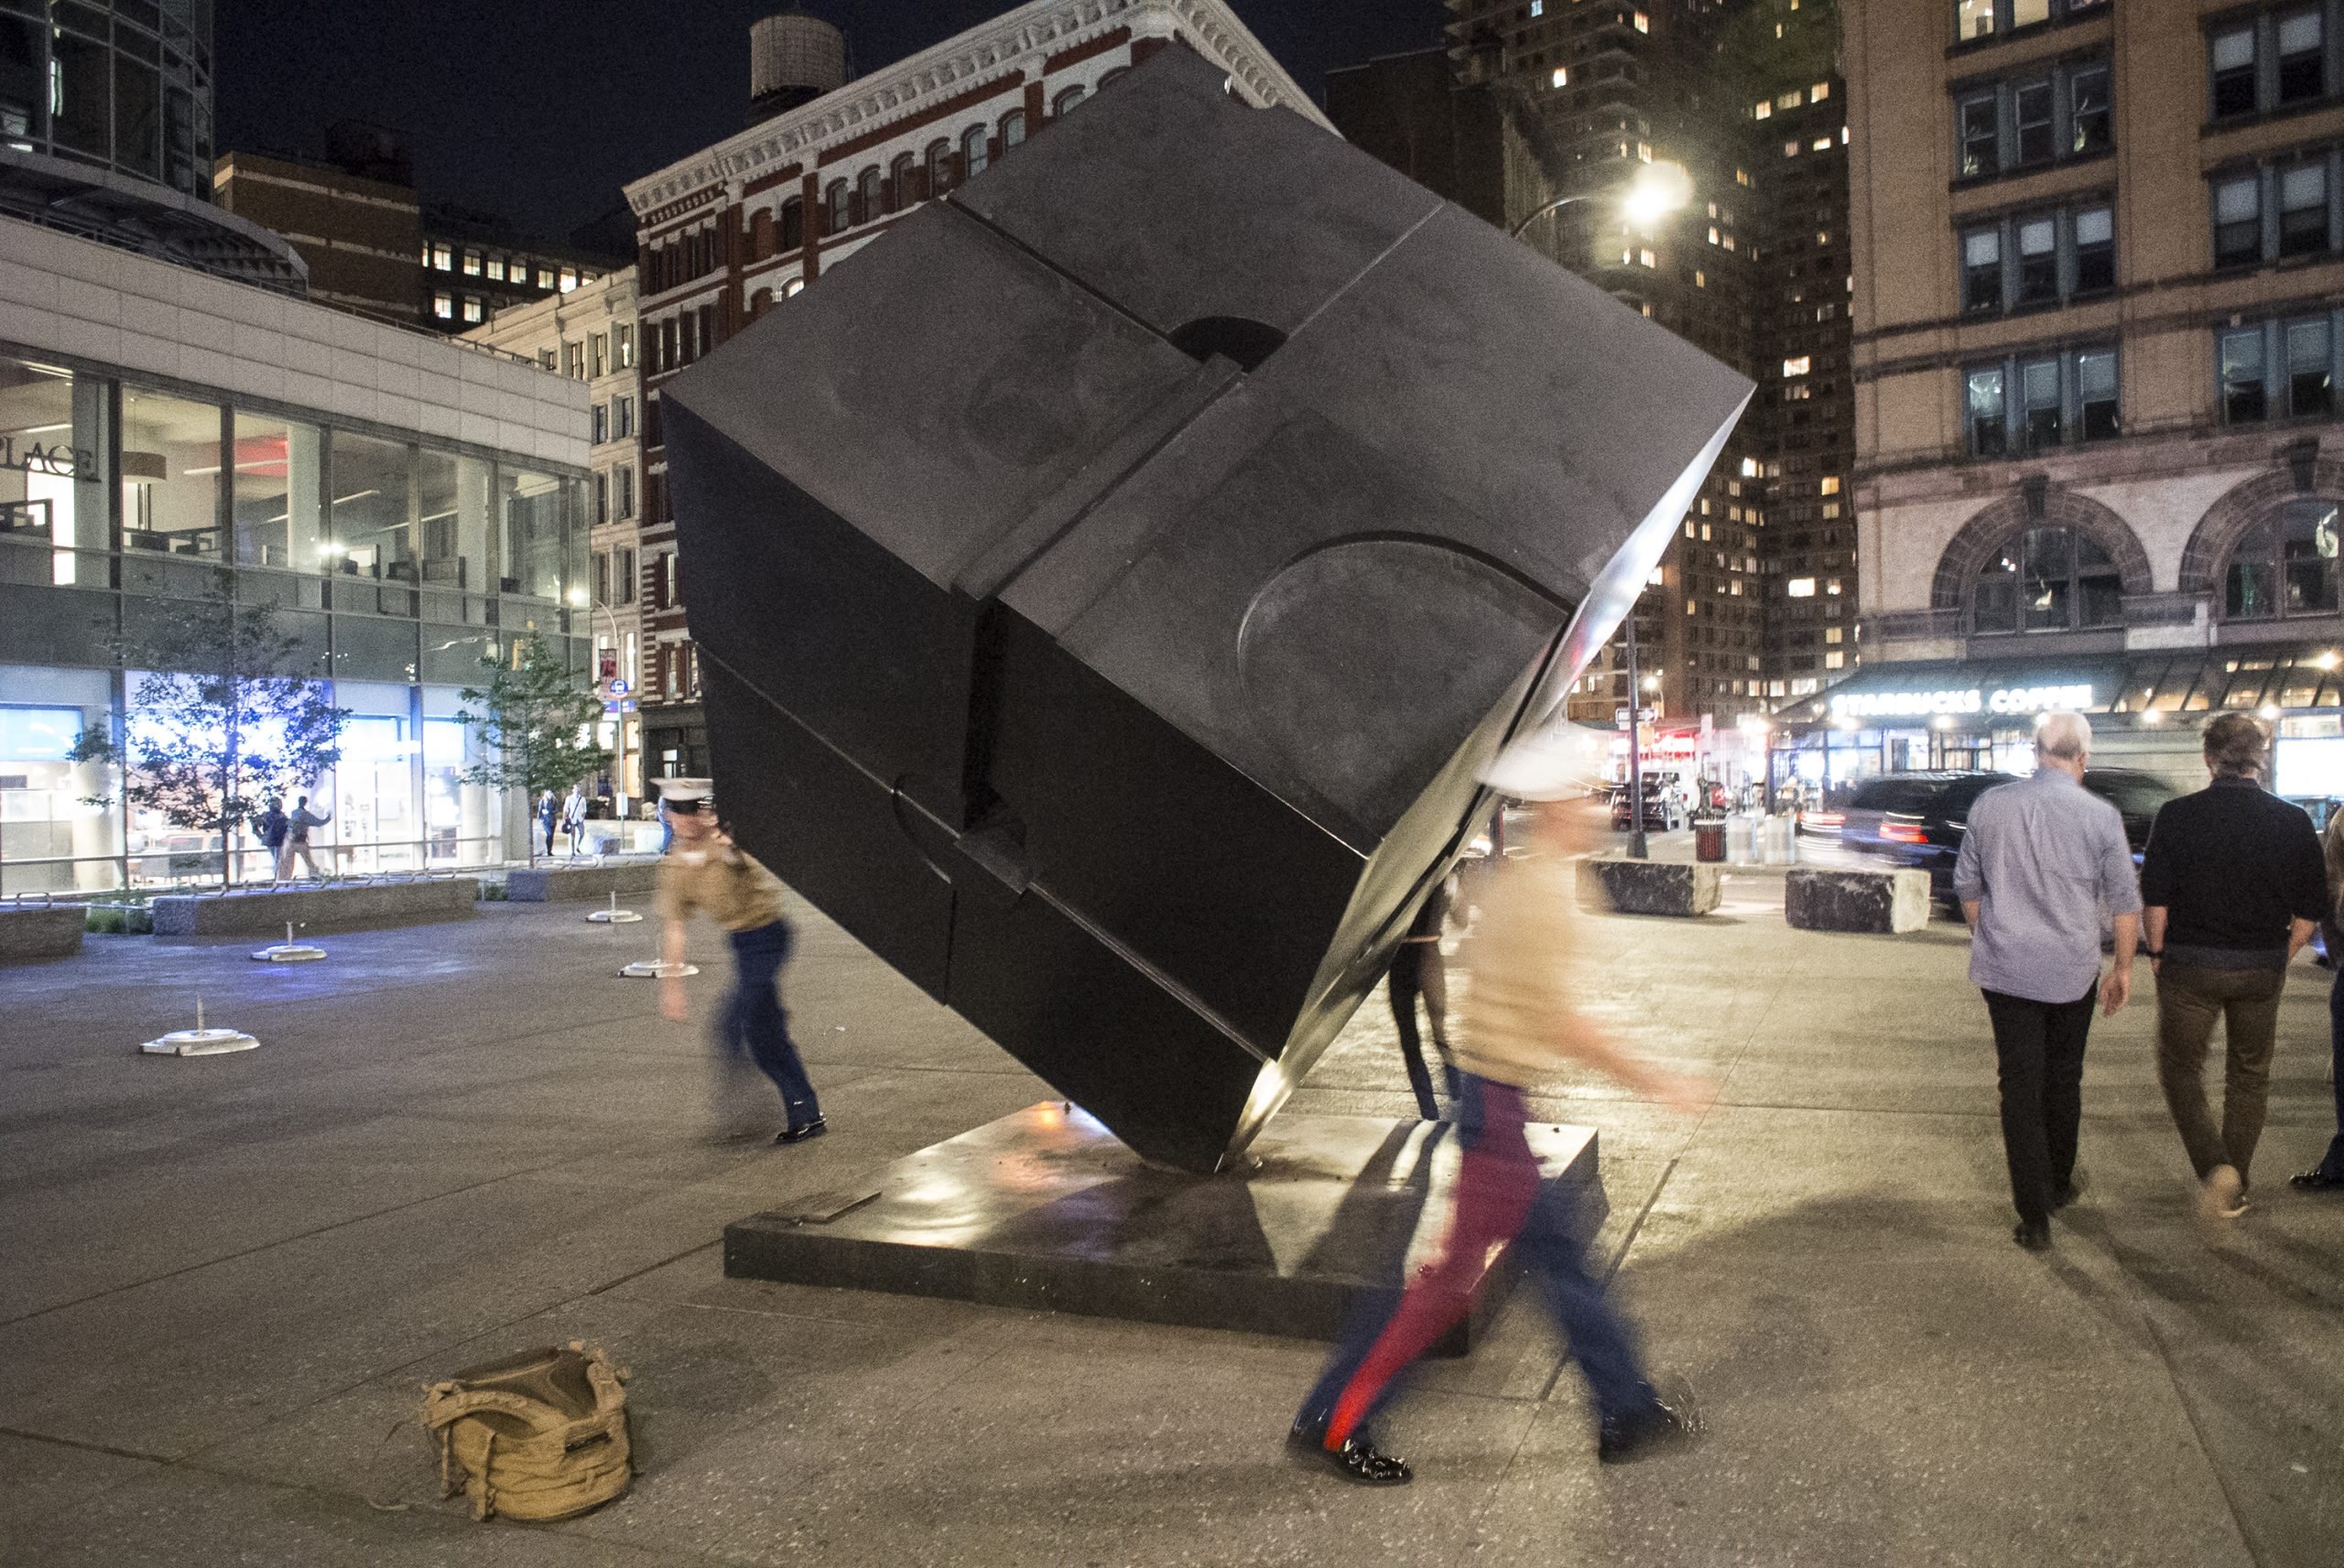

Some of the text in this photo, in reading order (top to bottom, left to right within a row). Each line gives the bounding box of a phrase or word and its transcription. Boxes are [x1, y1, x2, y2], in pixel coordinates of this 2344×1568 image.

[0, 436, 102, 482] LACE
[1830, 684, 2092, 716] STARBUCKS COFFEE
